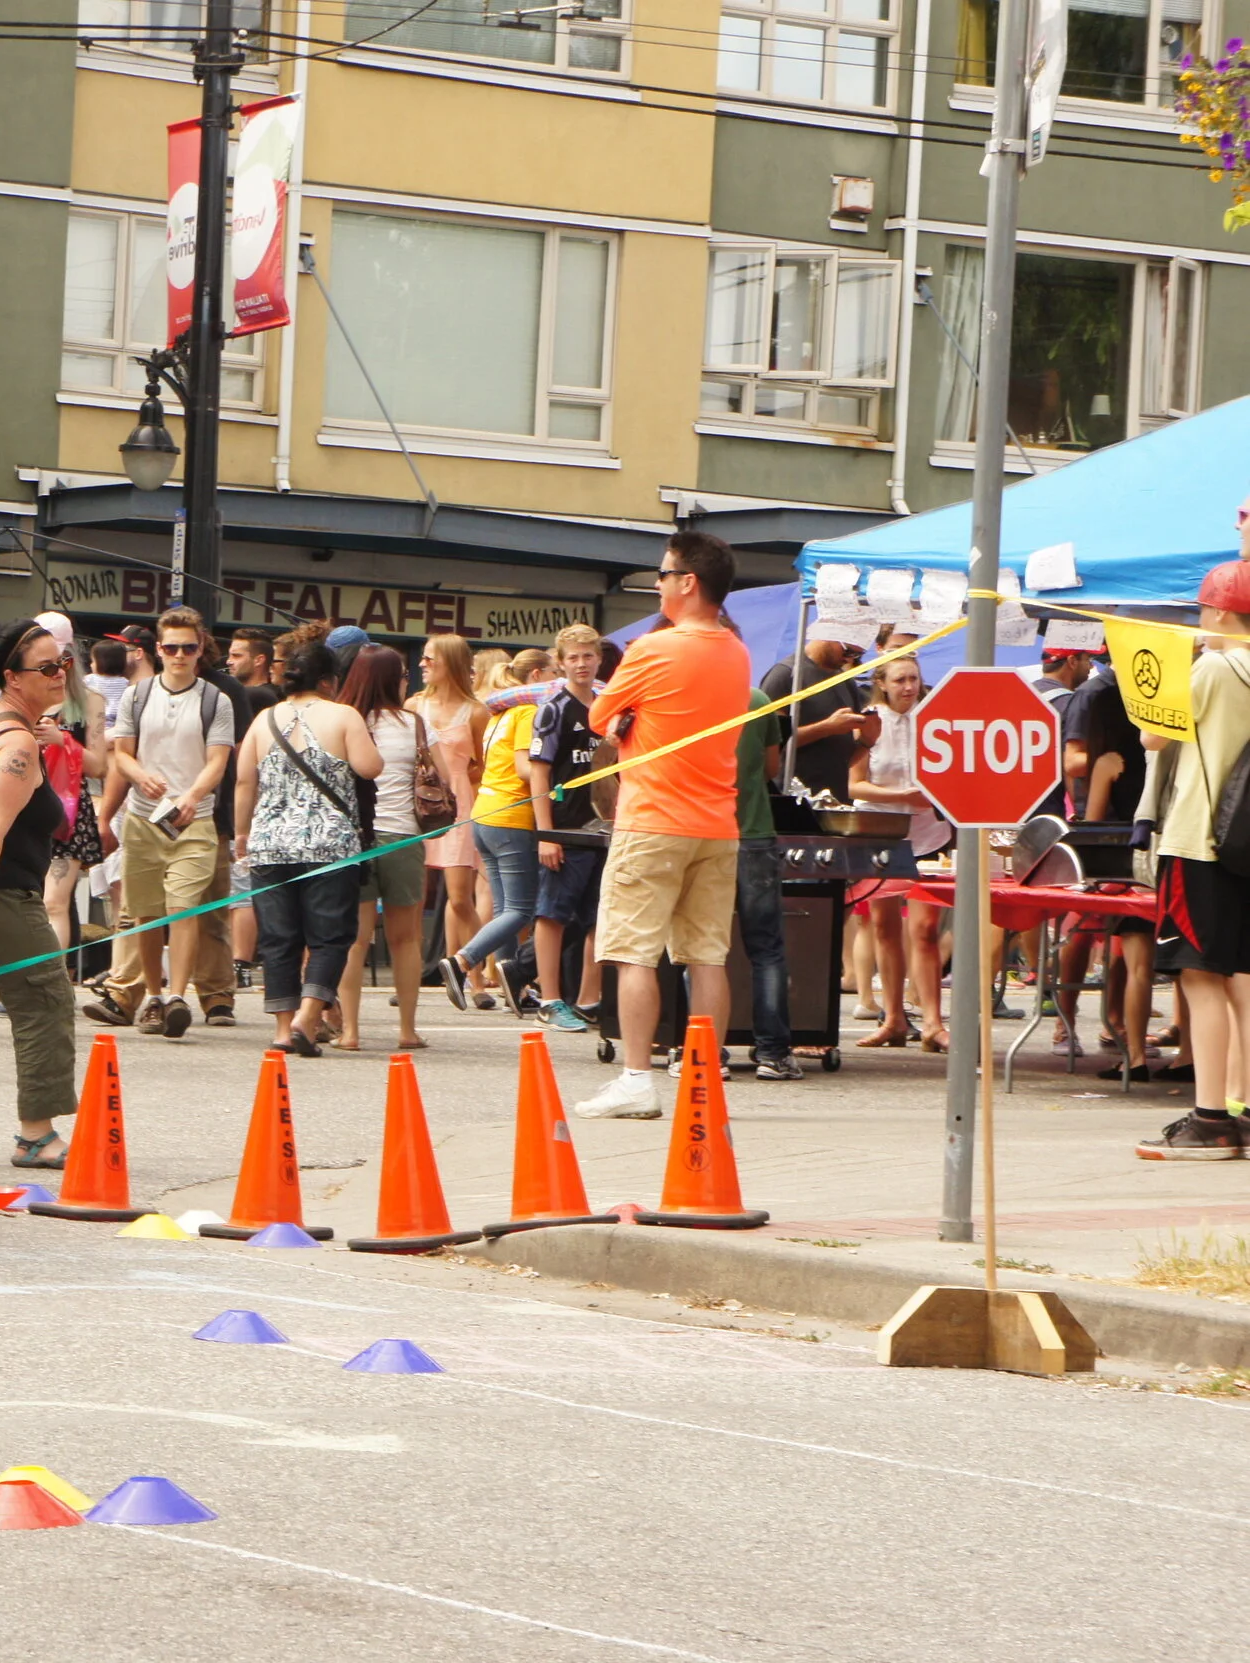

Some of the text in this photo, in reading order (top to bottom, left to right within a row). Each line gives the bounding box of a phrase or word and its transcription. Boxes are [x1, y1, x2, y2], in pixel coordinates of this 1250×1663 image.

[50, 569, 119, 606] DONAIR
[264, 583, 483, 639] FALAFEL
[486, 604, 592, 638] SHAWARMA
[921, 718, 1050, 775] STOP
